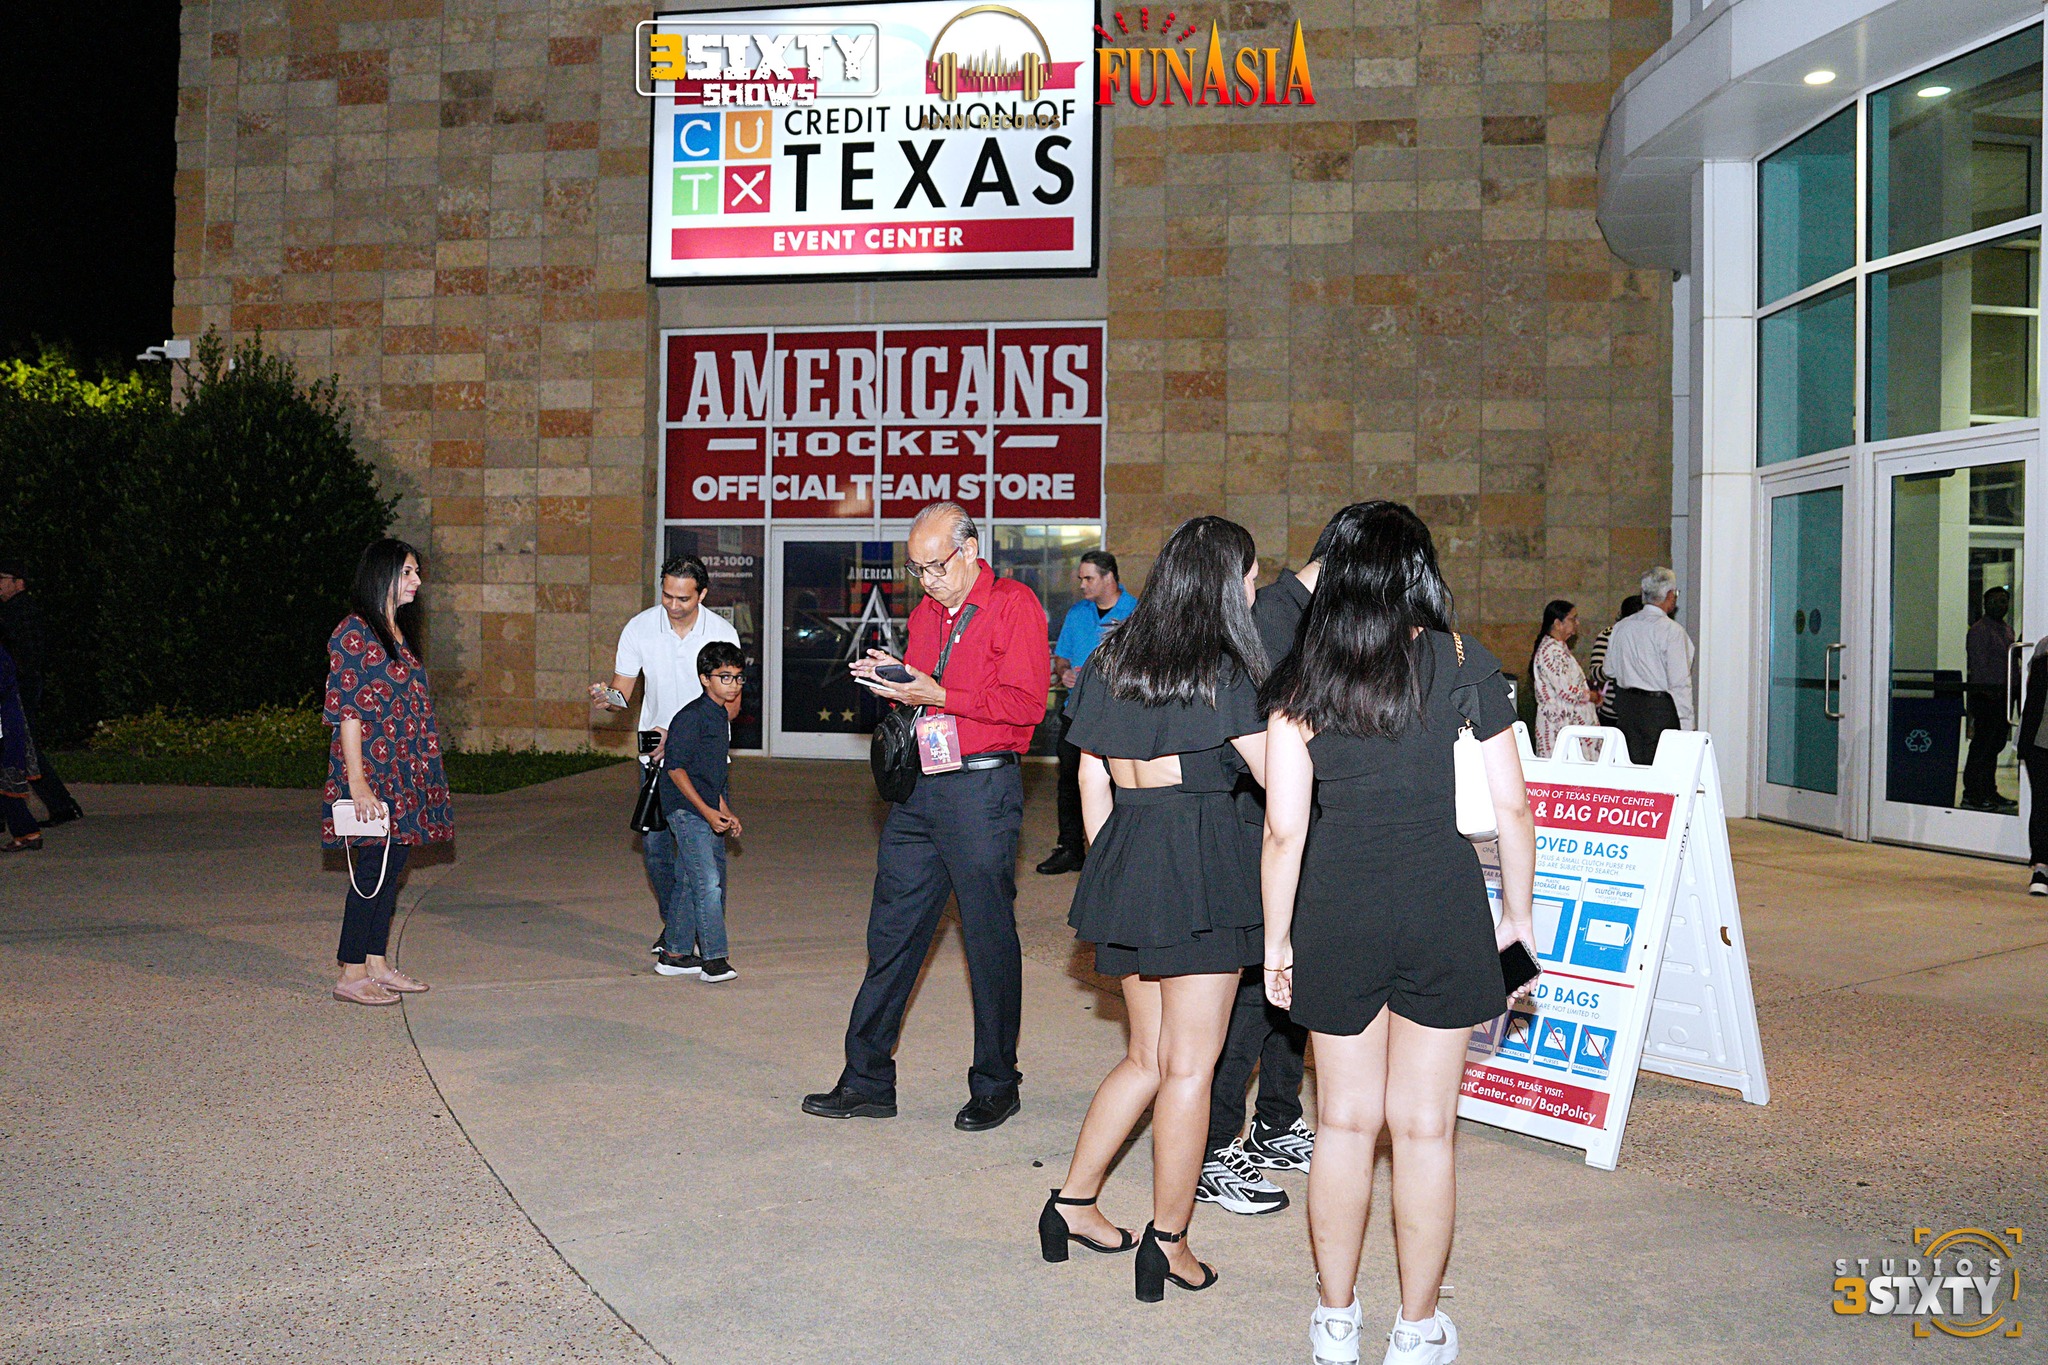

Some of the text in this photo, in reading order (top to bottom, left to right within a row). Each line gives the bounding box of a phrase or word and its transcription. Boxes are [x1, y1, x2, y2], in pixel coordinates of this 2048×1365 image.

[784, 99, 1075, 136] CREDIT UNION OF
[783, 134, 1075, 212] TEXAS
[773, 226, 964, 252] EVENT CENTER
[682, 343, 1089, 423] AMERICANS
[773, 429, 1000, 458] HOCKEY
[692, 472, 1076, 502] OFFICIAL TEAM STORE
[1526, 787, 1655, 808] NION OF TEXAS EVENT CENTER
[1535, 801, 1663, 829] & BAG POLICY
[1536, 836, 1629, 860] OVED BAGS
[1547, 861, 1558, 869] ARE
[1560, 863, 1584, 872] SUBJECT
[1595, 867, 1619, 876] SEARCH
[1562, 856, 1580, 865] SMALL
[1582, 858, 1604, 867] CLUTCH
[1606, 861, 1624, 870] PURSE
[1594, 887, 1633, 898] CLUTCH PURSE
[1554, 987, 1600, 1009] BAGS
[1552, 1005, 1566, 1013] NOT
[1567, 1007, 1590, 1018] LIMITED
[1591, 1012, 1600, 1020] TO
[1465, 1068, 1565, 1098] MORE DETAILS, PLEASE VISIT:
[1461, 1081, 1597, 1125] ntCenter.com/BagPolicy
